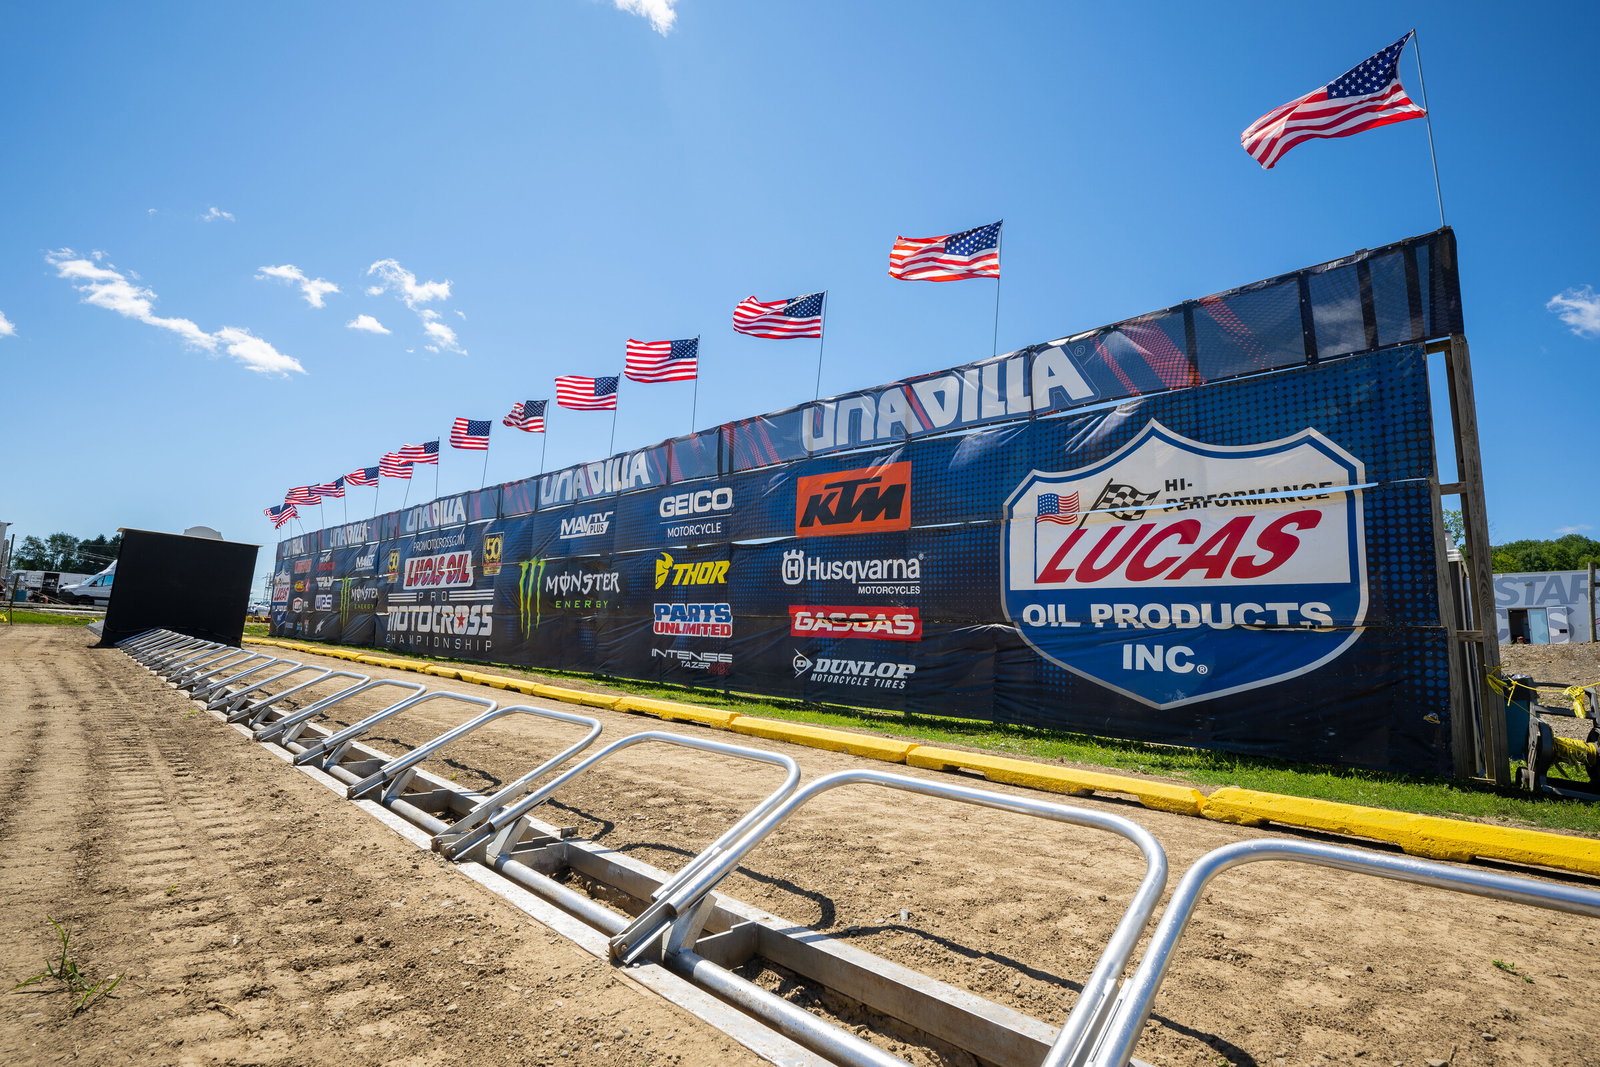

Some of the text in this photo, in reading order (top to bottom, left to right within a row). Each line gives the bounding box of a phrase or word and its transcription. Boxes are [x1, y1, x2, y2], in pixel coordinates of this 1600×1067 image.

[802, 346, 1094, 452] UNADILLA
[540, 452, 651, 505] UNADILLA
[1164, 477, 1193, 492] HI-
[659, 487, 733, 518] GEICO
[799, 476, 906, 527] KTM
[1163, 481, 1333, 512] PERFORMANCE
[405, 496, 467, 532] UNADILLA
[589, 523, 604, 534] PLUS
[667, 522, 722, 538] MOTORCYCLE
[485, 537, 501, 561] 50
[1035, 508, 1321, 583] LUCAS
[406, 554, 470, 586] LUCAS OIL
[672, 561, 731, 585] THOR
[807, 556, 921, 584] Husqvarna
[546, 570, 621, 596] MONSTER
[857, 585, 921, 595] MOTORCYCLES
[418, 590, 447, 602] PRO
[555, 600, 609, 609] ENERGY
[387, 604, 494, 636] MOTOCROSS
[654, 604, 732, 623] PARTS
[794, 611, 916, 635] GASGAS
[1022, 602, 1337, 632] OIL PRODUCTS
[654, 621, 732, 637] UNLIMITED
[386, 633, 492, 651] CHAMPIONSHIP
[651, 648, 733, 664] INTENSE
[680, 660, 711, 670] TAZER
[813, 658, 917, 679] DUNLOP
[810, 673, 907, 690] MOTORCYCLE TIRES
